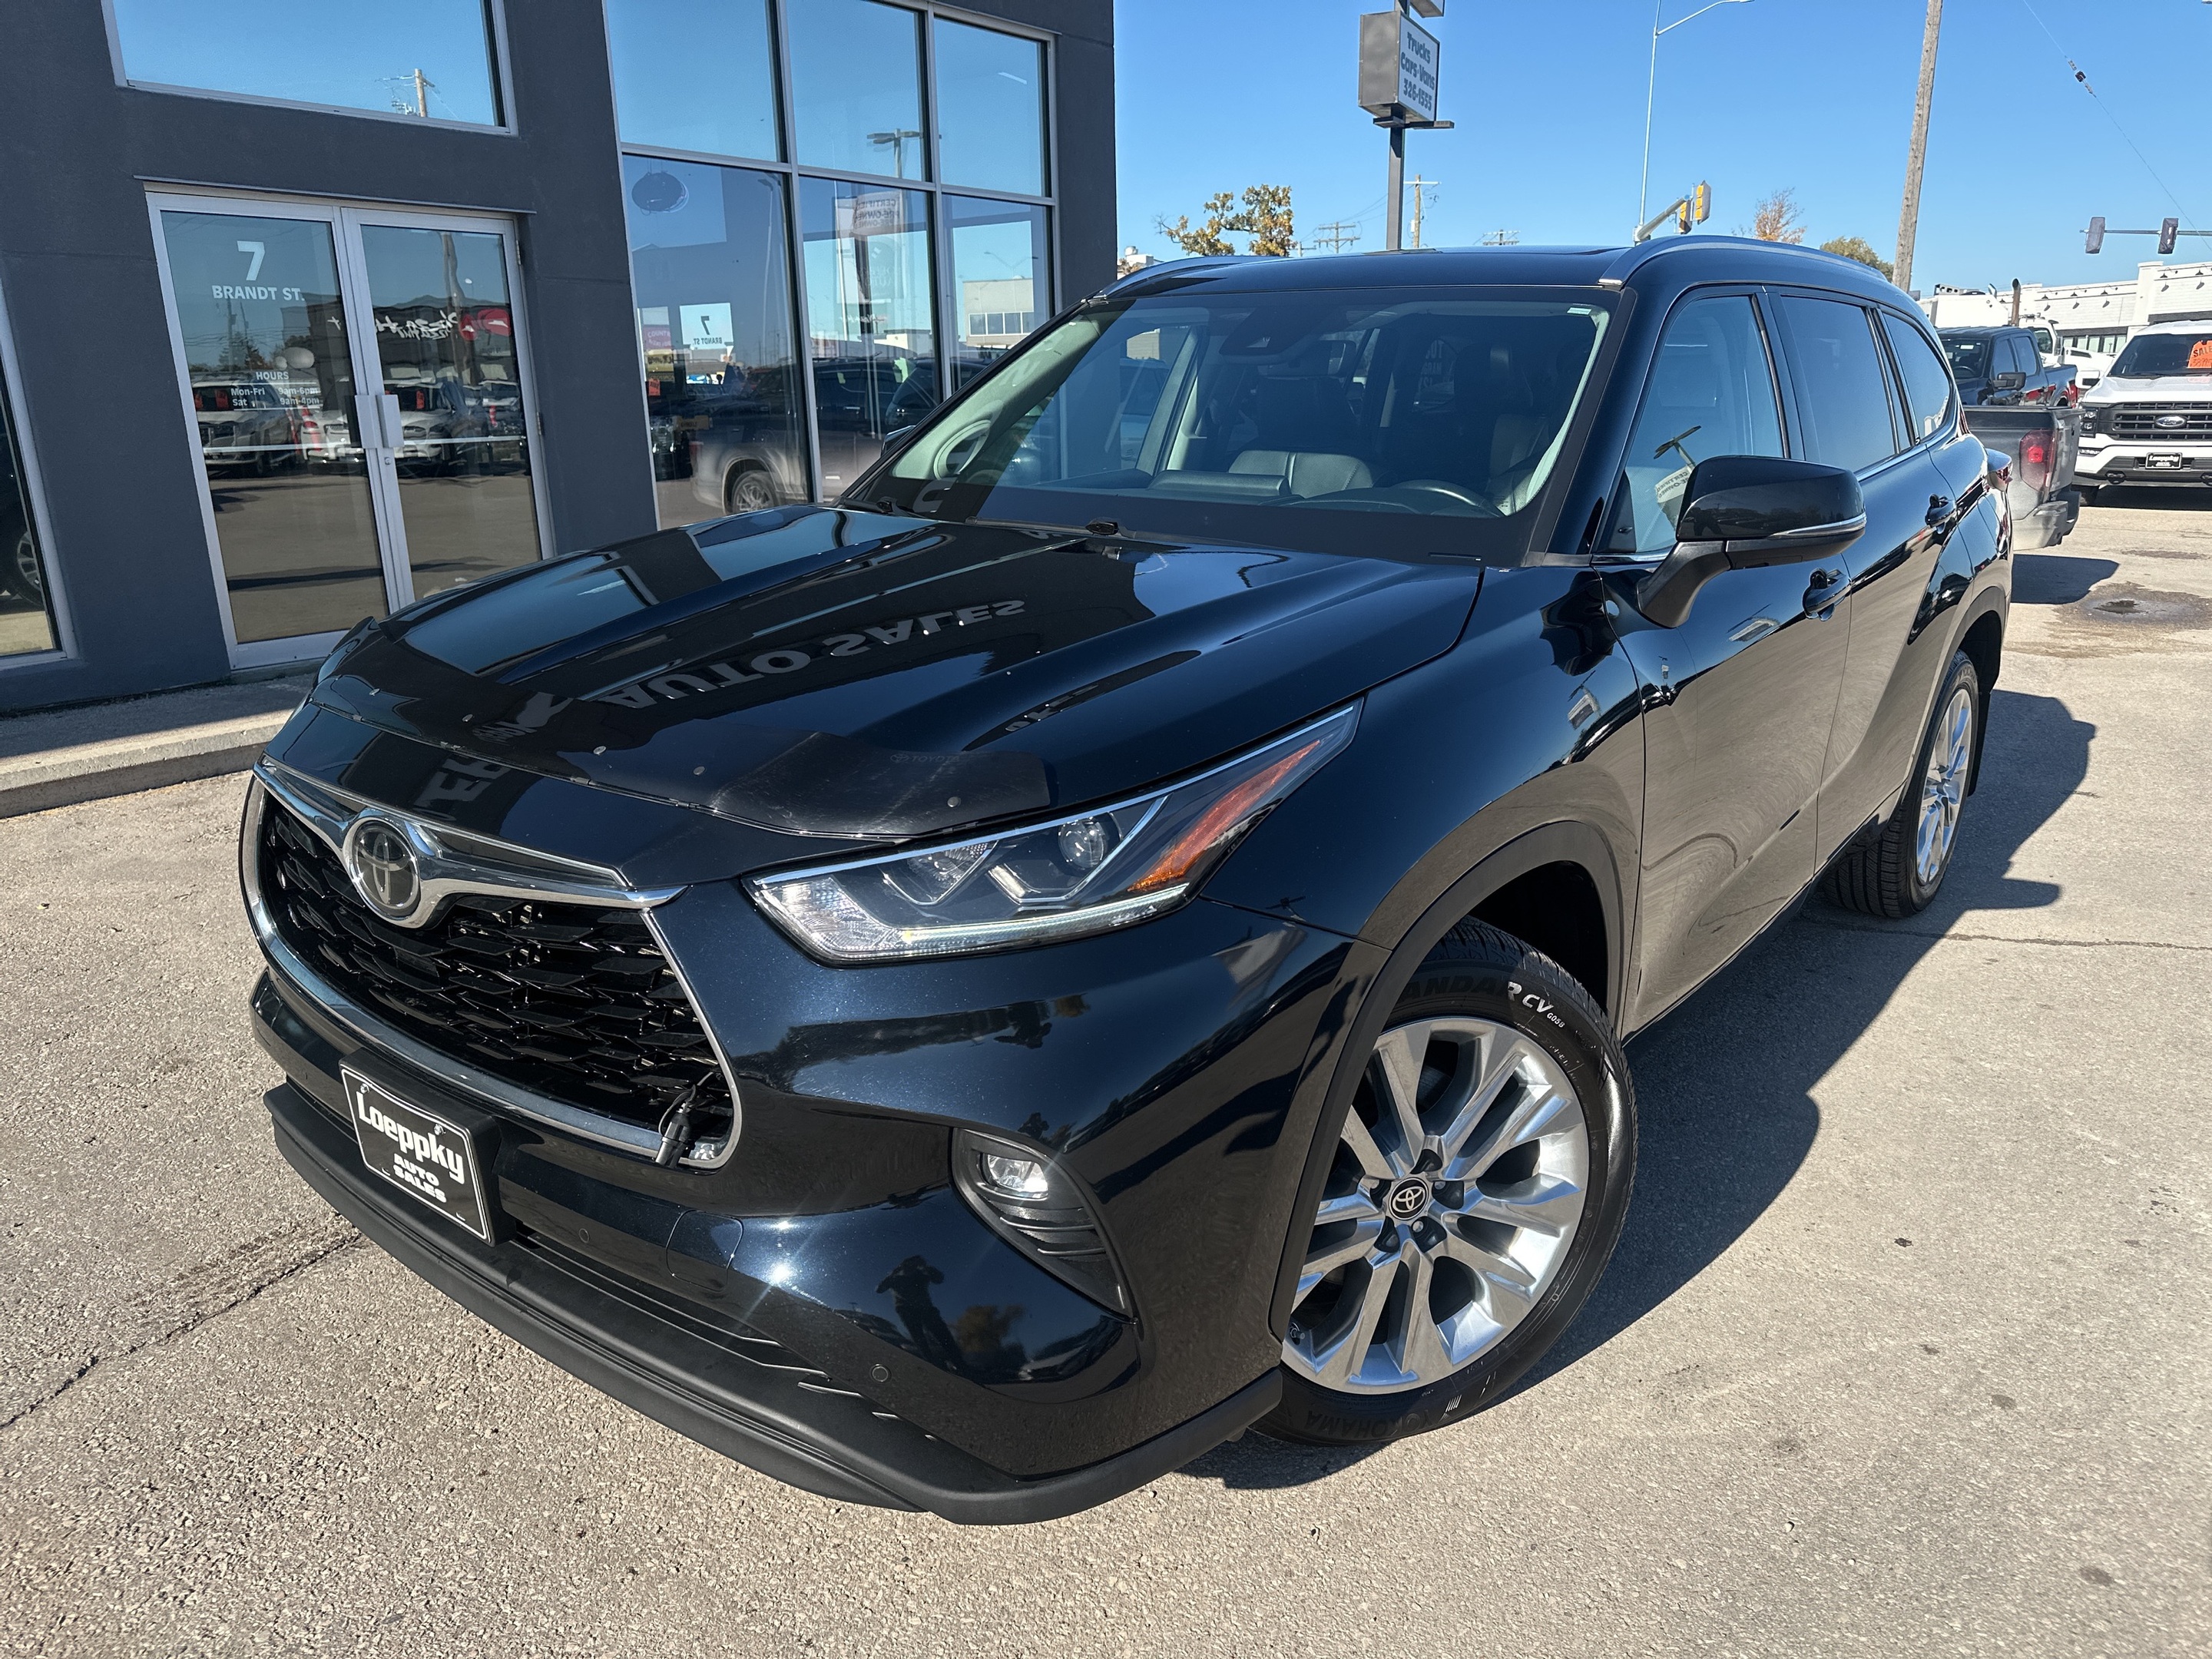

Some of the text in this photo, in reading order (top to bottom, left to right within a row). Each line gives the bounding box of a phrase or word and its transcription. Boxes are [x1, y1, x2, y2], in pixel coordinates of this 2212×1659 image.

[1407, 31, 1430, 65] Trucks
[1403, 78, 1432, 111] 326-1555
[237, 240, 266, 281] 7
[211, 285, 305, 301] BRANDT ST.
[230, 386, 320, 397] Mon-Fri 9am-6pm
[256, 371, 290, 381] HOURS
[232, 396, 320, 407] Sat 9am-4pm
[1404, 975, 1522, 1002] ANDAR
[1522, 994, 1555, 1013] CV
[356, 1091, 465, 1185] Loeppky
[392, 1164, 447, 1203] SALES
[393, 1153, 439, 1187] AUTO
